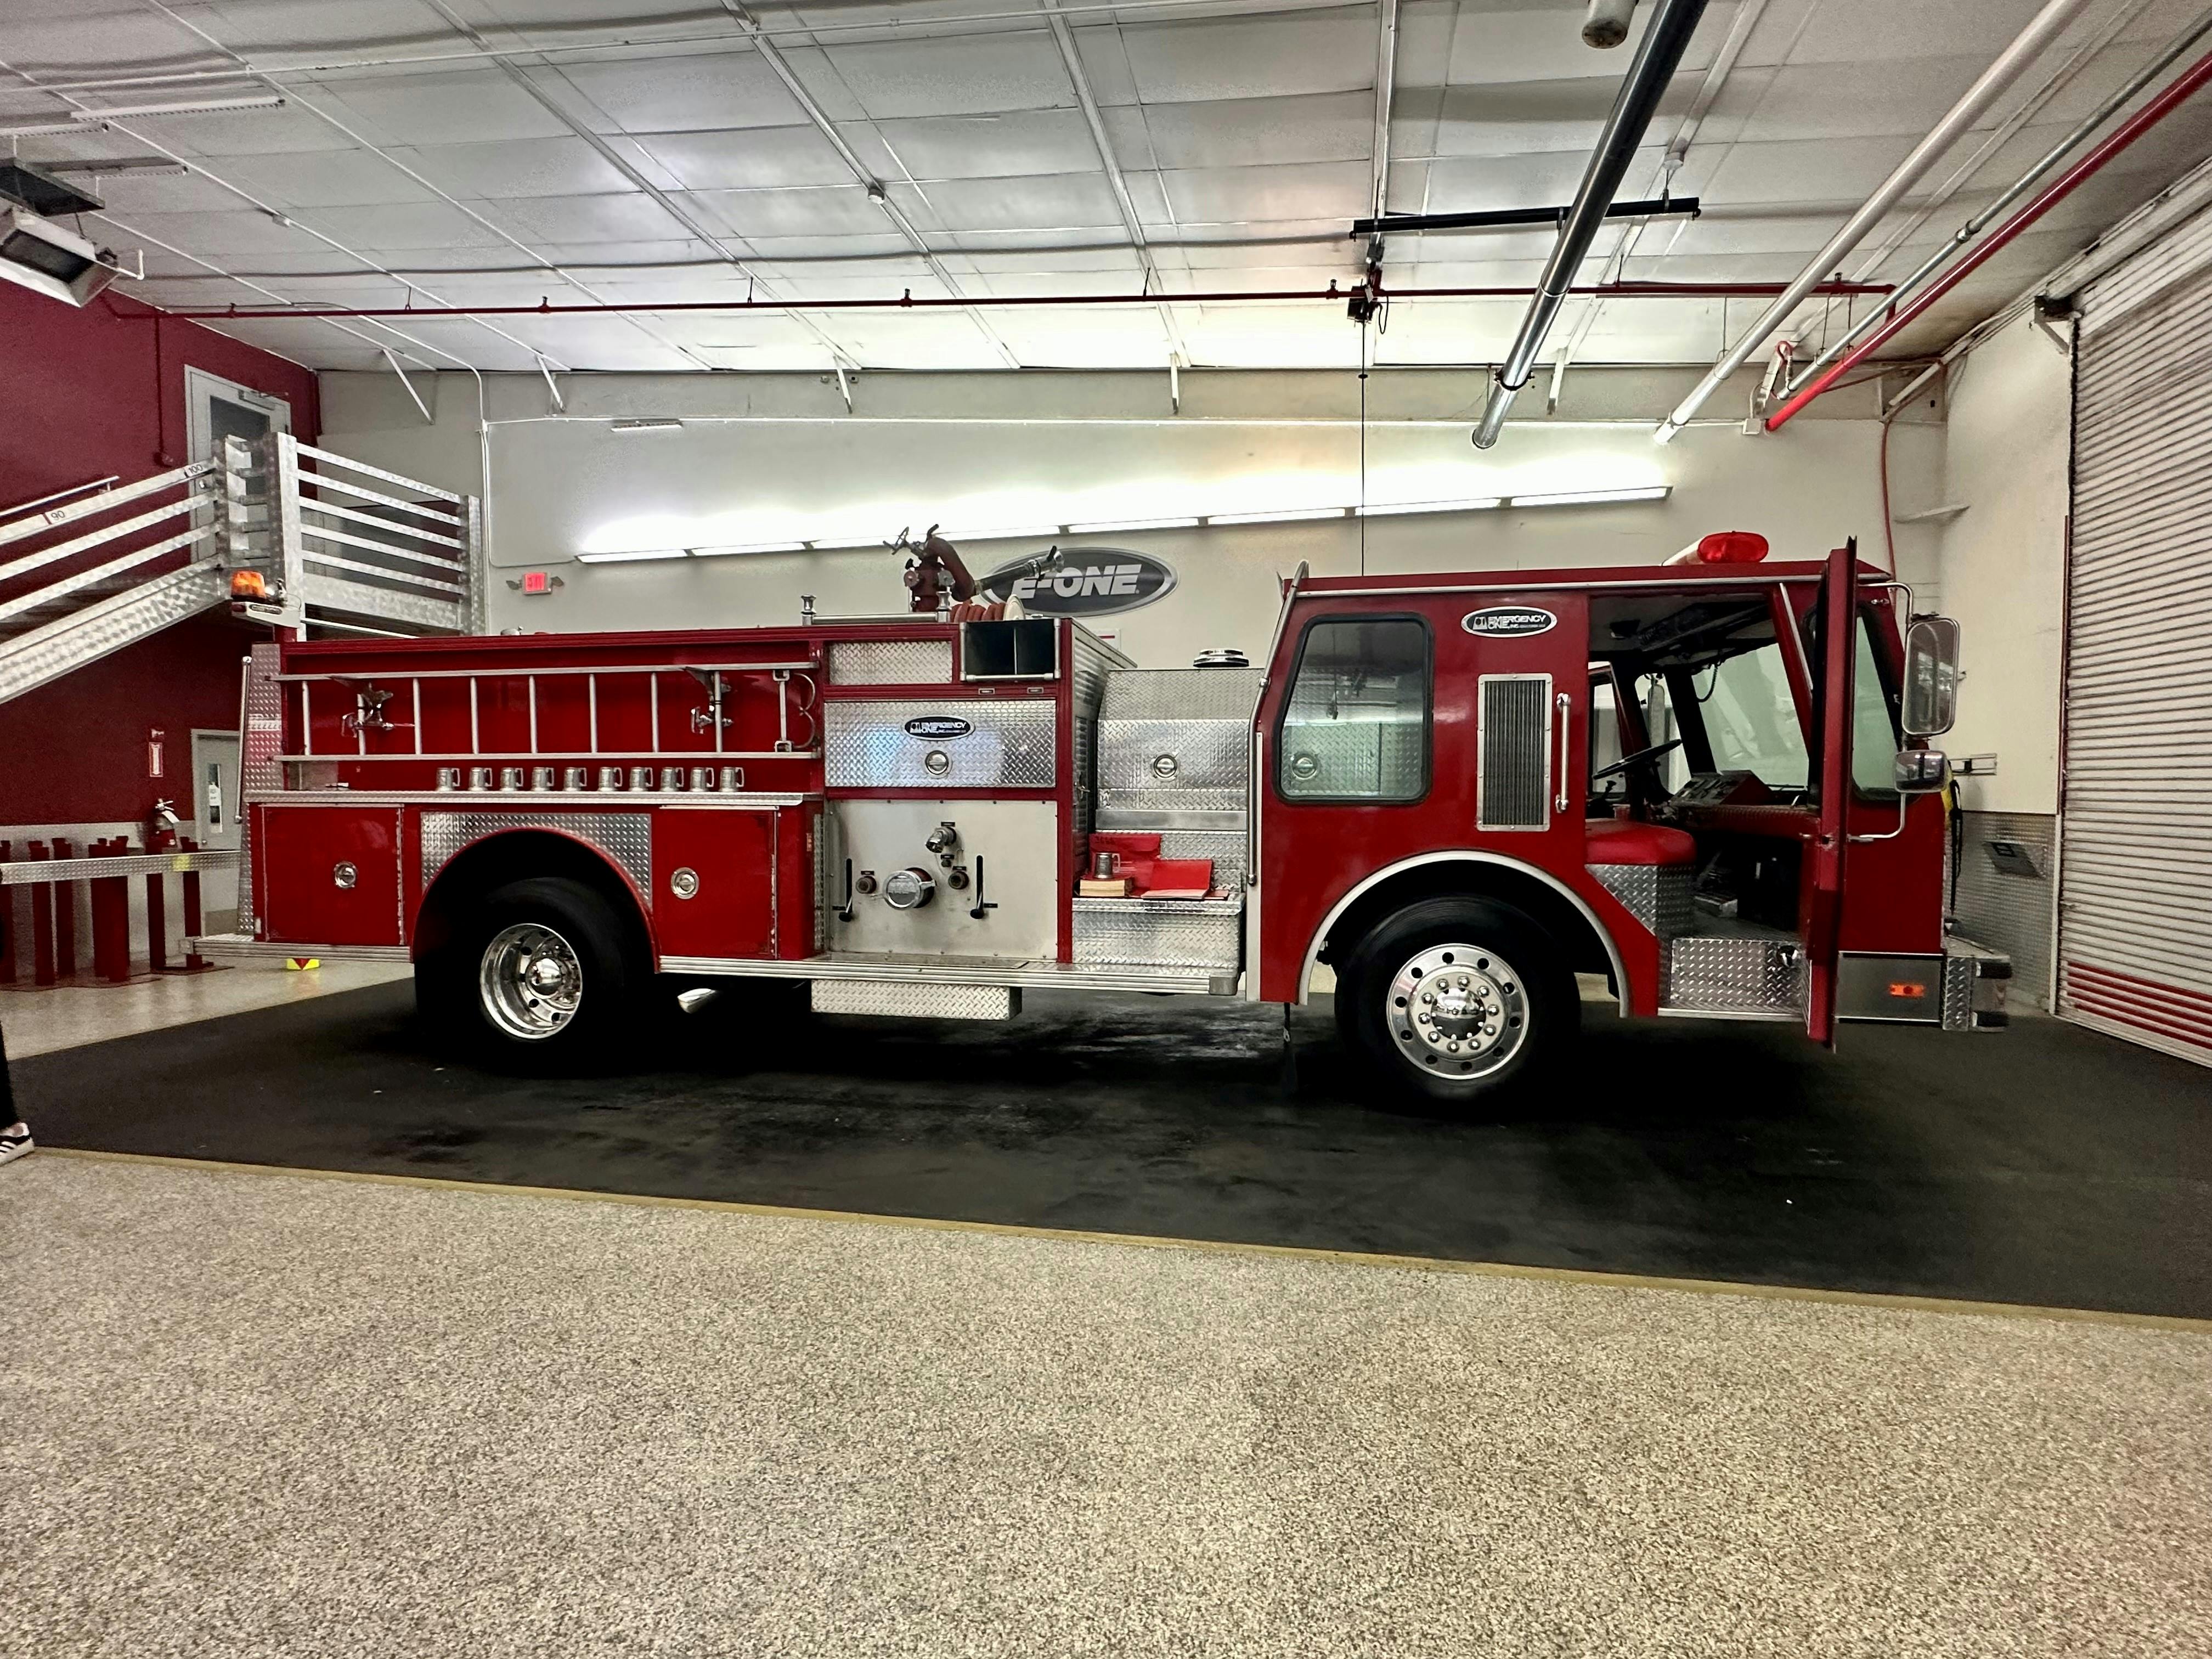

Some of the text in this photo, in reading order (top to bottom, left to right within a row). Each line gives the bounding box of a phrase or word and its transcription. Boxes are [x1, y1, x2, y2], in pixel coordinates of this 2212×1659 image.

[188, 464, 202, 474] 100
[50, 510, 65, 521] 90
[1012, 564, 1142, 599] E-ONE
